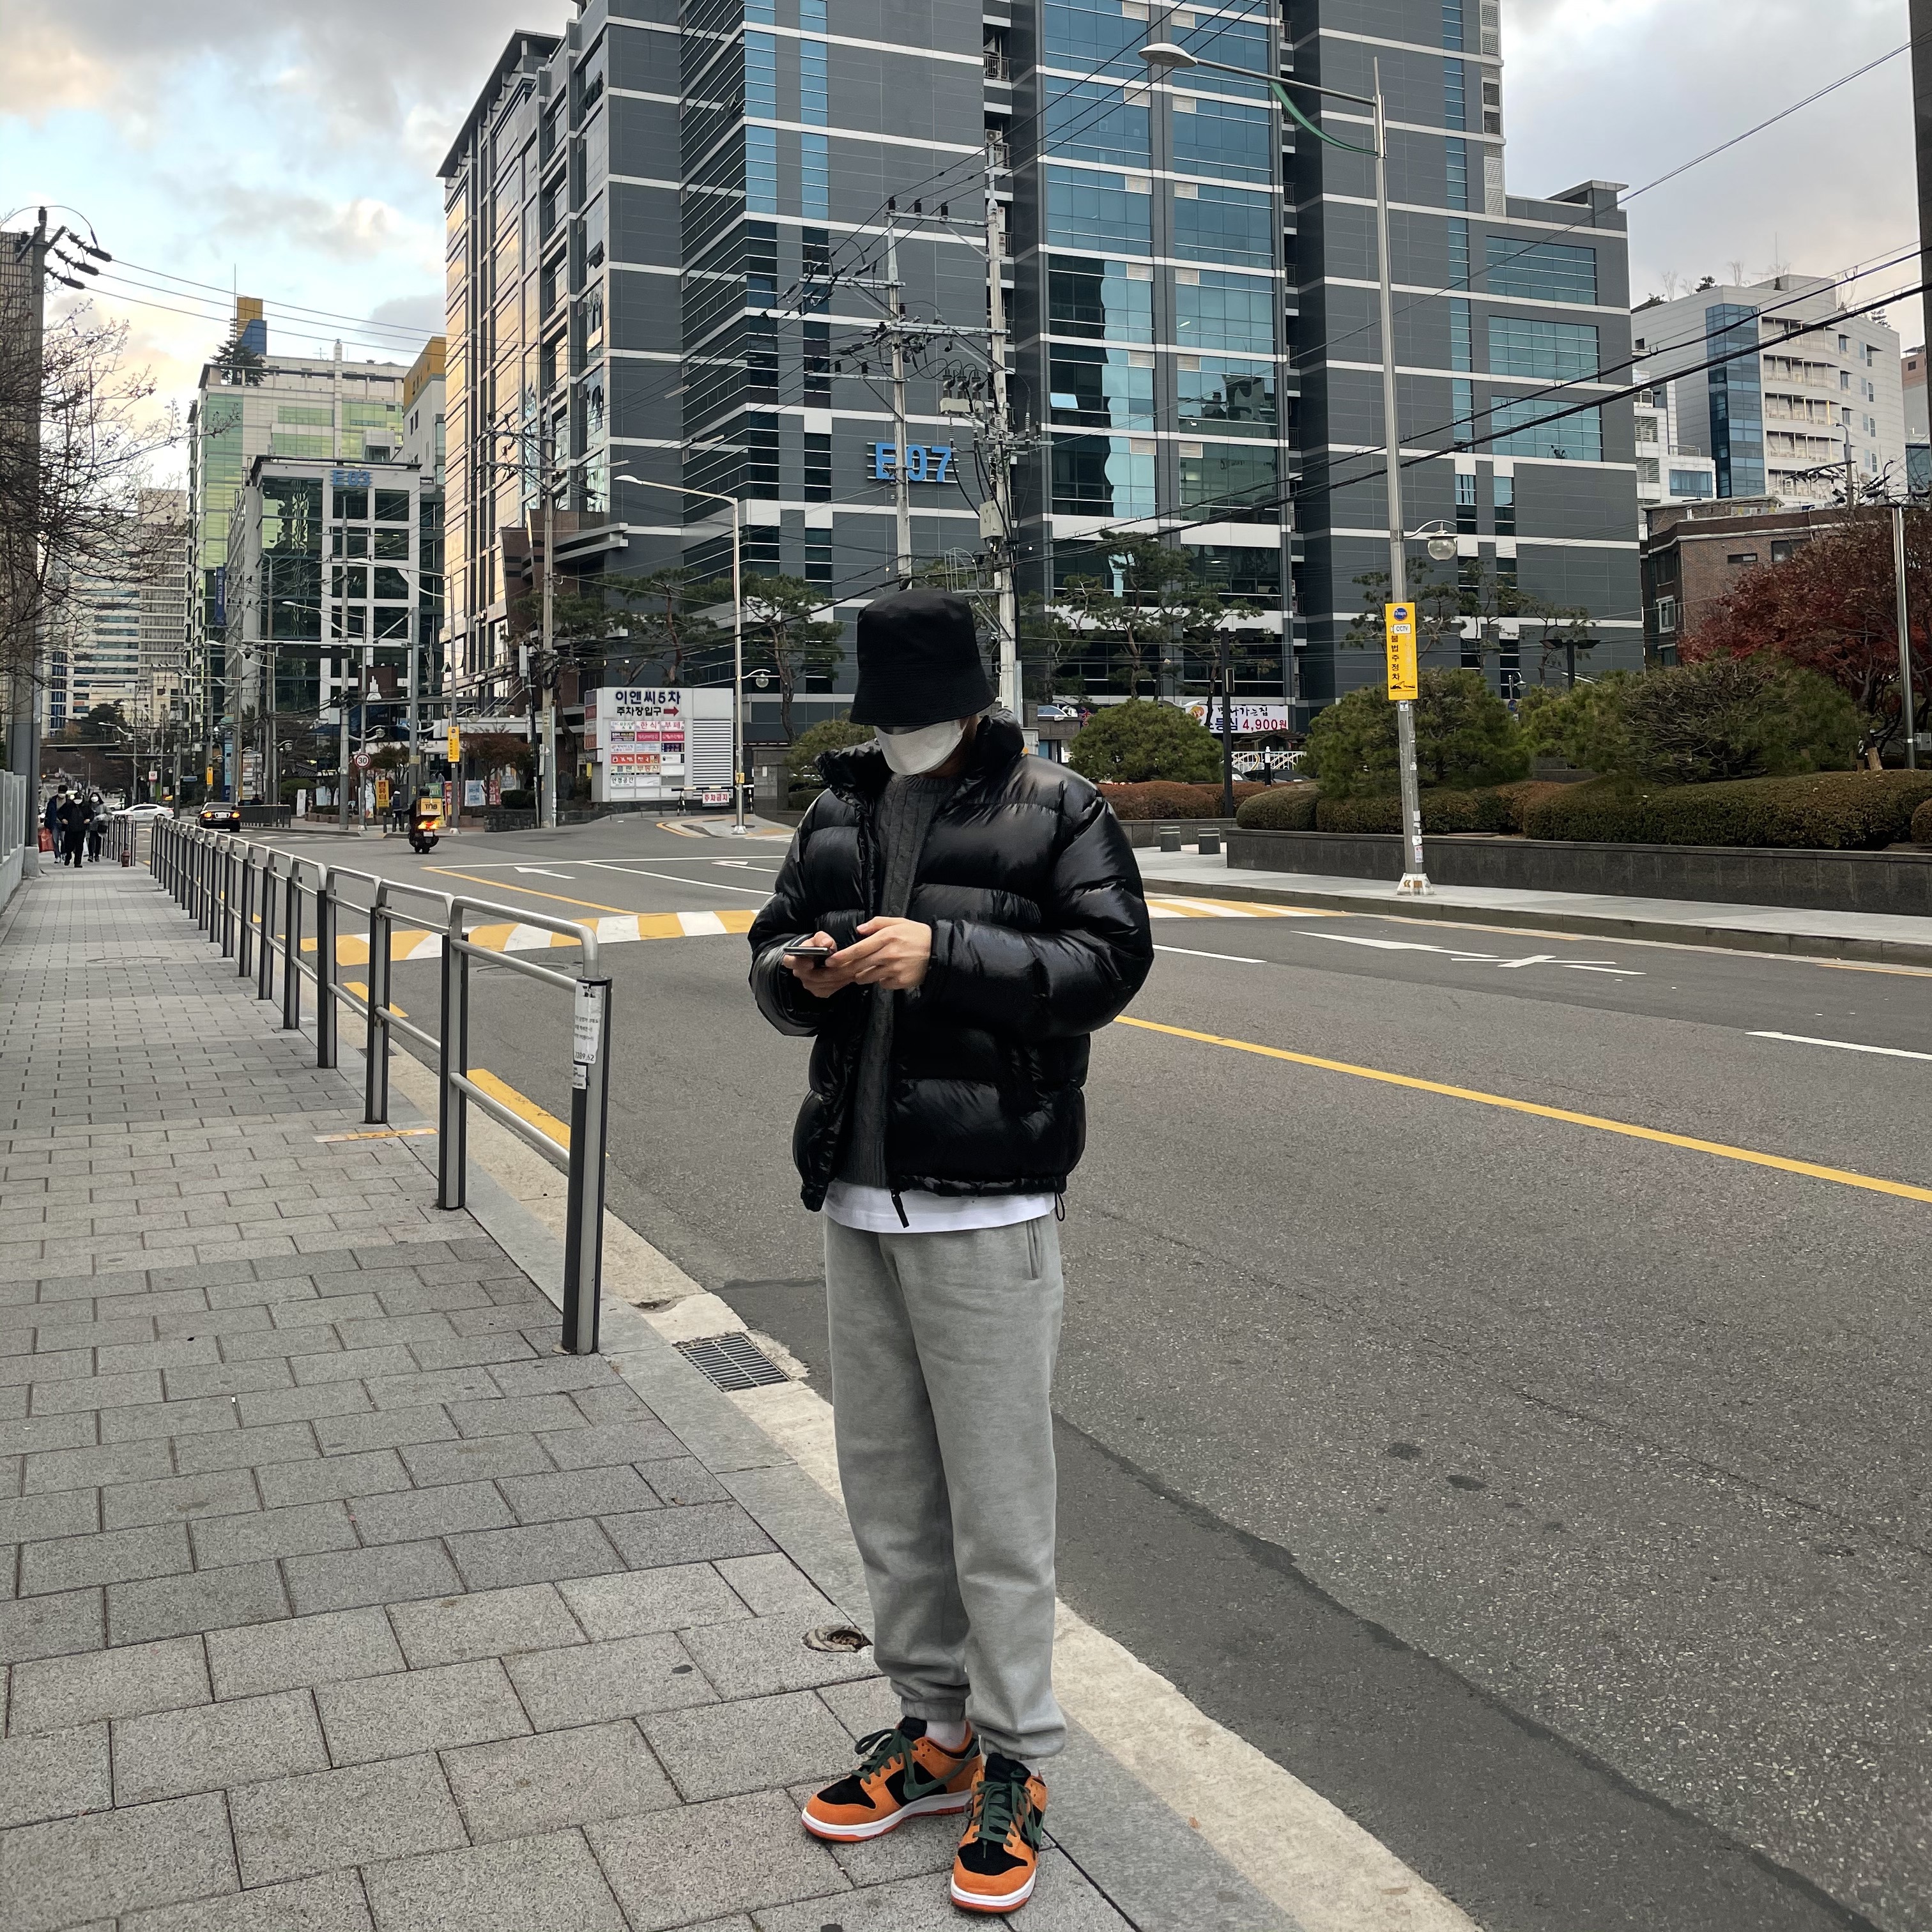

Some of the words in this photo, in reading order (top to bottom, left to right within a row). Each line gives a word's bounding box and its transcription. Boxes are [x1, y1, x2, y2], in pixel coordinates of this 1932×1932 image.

[876, 442, 951, 482] E07
[332, 470, 371, 487] E03
[1391, 634, 1400, 681] 불법주정차
[615, 691, 681, 705] 이앤씨5차
[617, 706, 662, 716] 주차장입구
[641, 721, 657, 730] 한식
[665, 721, 680, 730] 부페
[1242, 719, 1287, 732] 4,900원
[705, 793, 728, 802] 주차금지
